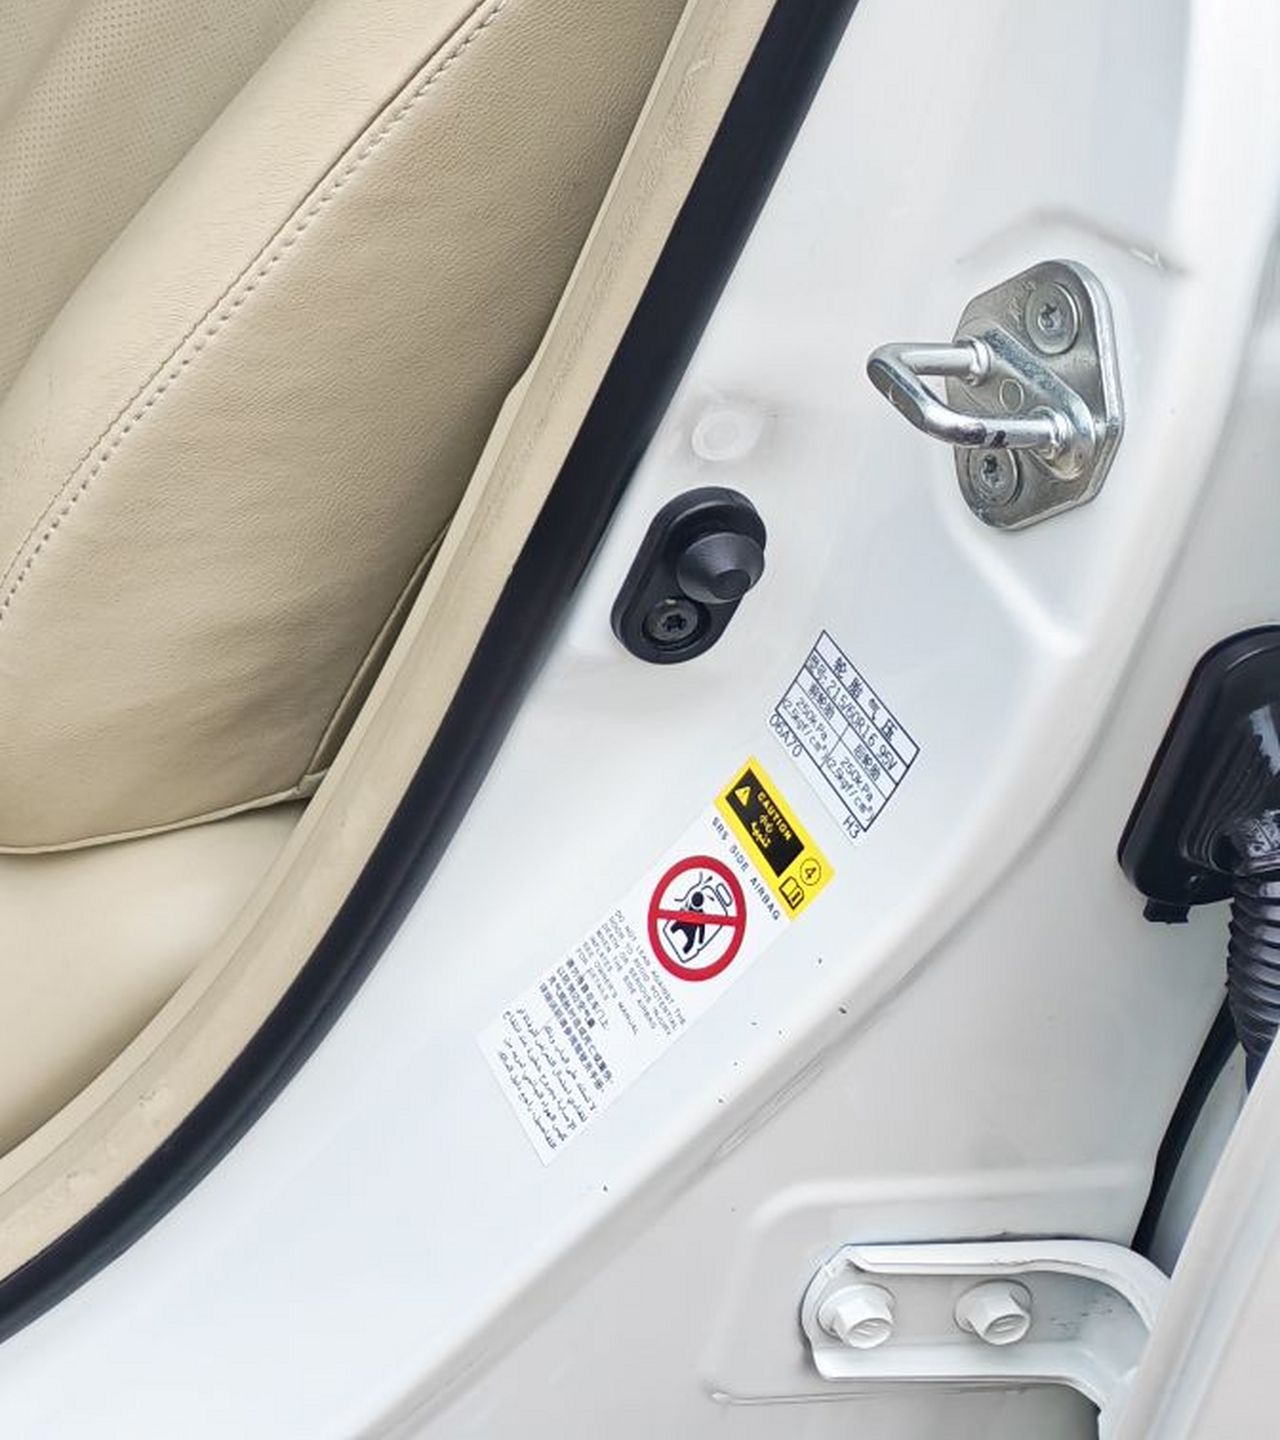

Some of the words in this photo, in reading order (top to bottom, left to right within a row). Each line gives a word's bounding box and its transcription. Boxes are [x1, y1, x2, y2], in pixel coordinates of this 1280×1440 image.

[830, 654, 899, 743] 轮胎气压
[767, 711, 803, 760] 06A70
[755, 789, 794, 841] CAUTION
[840, 813, 861, 841] H3
[748, 875, 780, 922] AIRBAG
